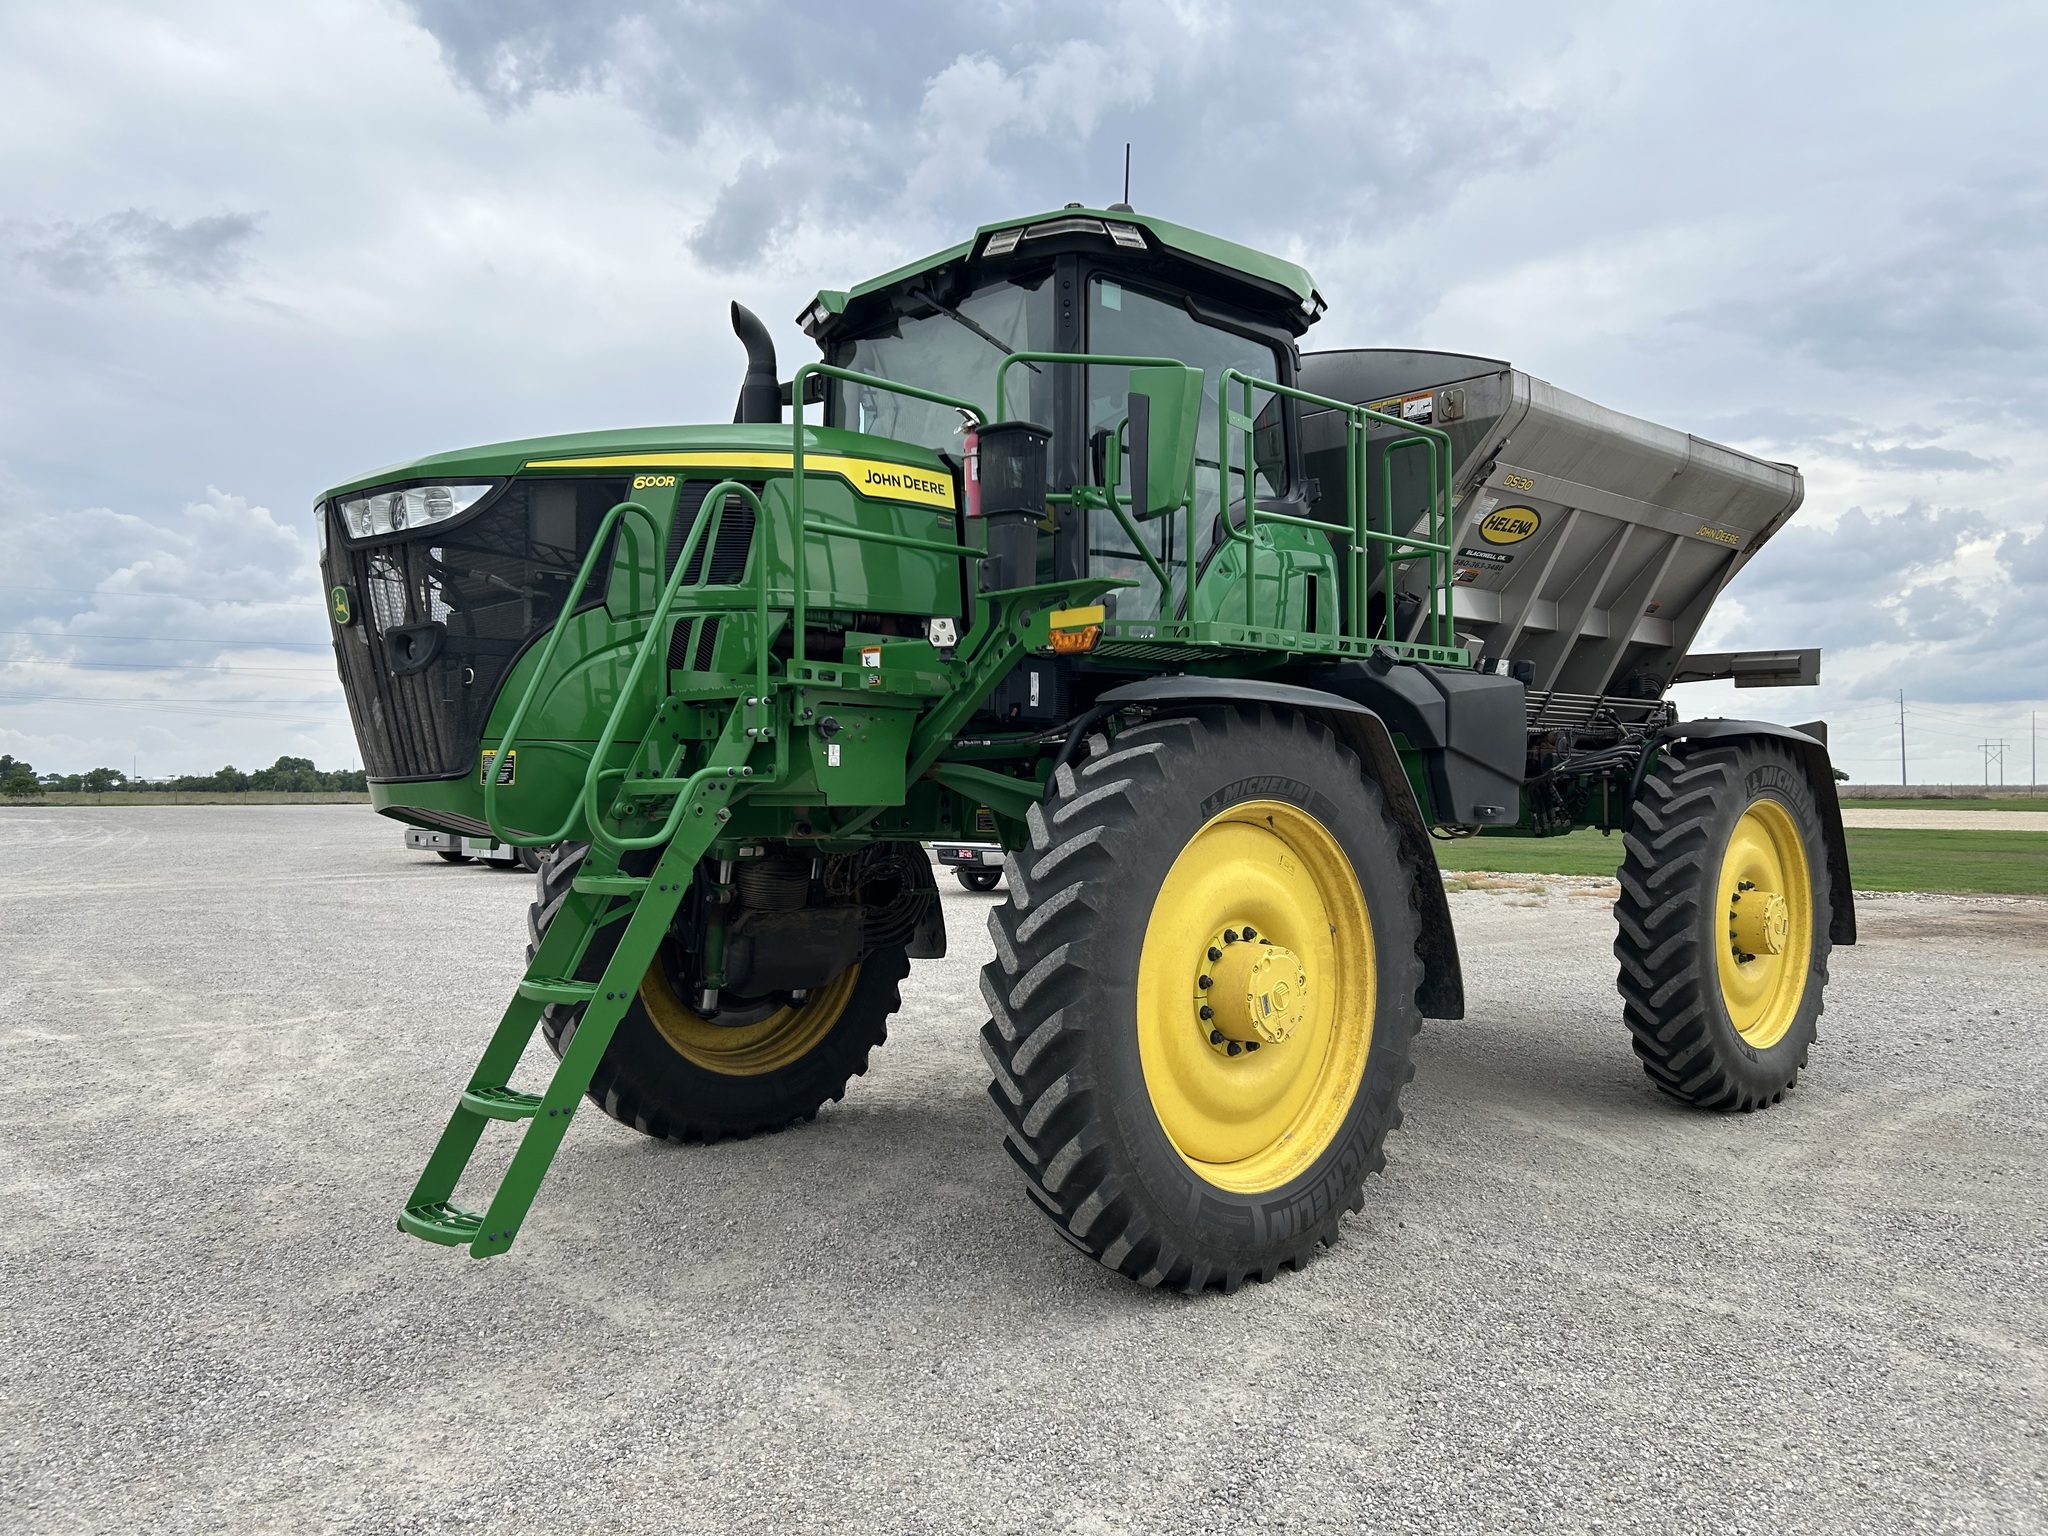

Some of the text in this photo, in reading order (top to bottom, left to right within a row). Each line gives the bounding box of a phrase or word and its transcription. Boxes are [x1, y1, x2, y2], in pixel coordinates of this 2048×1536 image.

[633, 475, 675, 490] 600R
[864, 469, 946, 496] JOHN DEERE
[1484, 515, 1533, 535] HELENA
[1695, 523, 1740, 545] JOHN DEERE
[1223, 776, 1311, 803] MICHELIN
[1761, 767, 1812, 826] MICHELIN
[1270, 1102, 1381, 1237] MICHELIN
